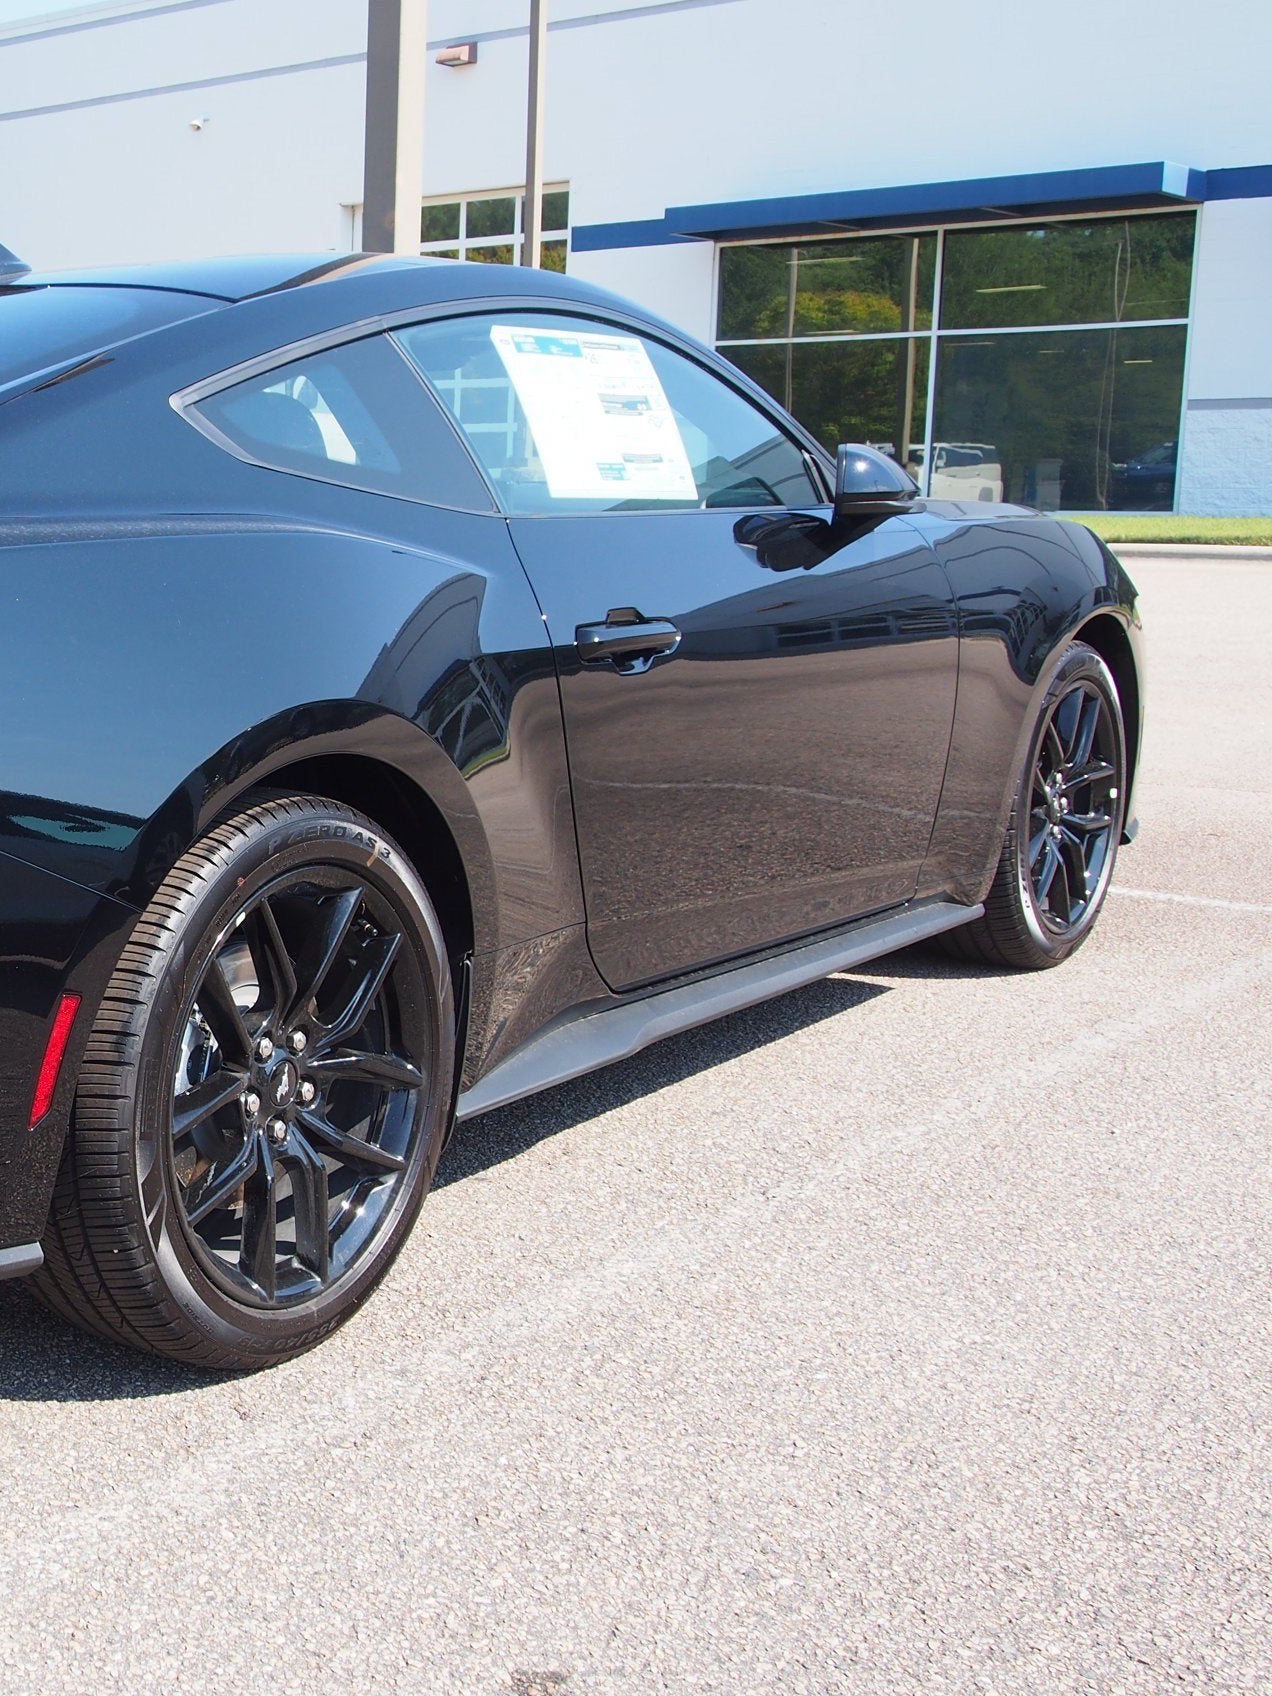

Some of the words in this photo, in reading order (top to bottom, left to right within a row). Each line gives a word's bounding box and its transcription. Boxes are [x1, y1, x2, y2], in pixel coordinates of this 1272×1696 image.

[288, 825, 348, 845] ZERO
[352, 831, 378, 850] AS
[381, 846, 392, 859] 3
[181, 1302, 215, 1334] OUTSIDE
